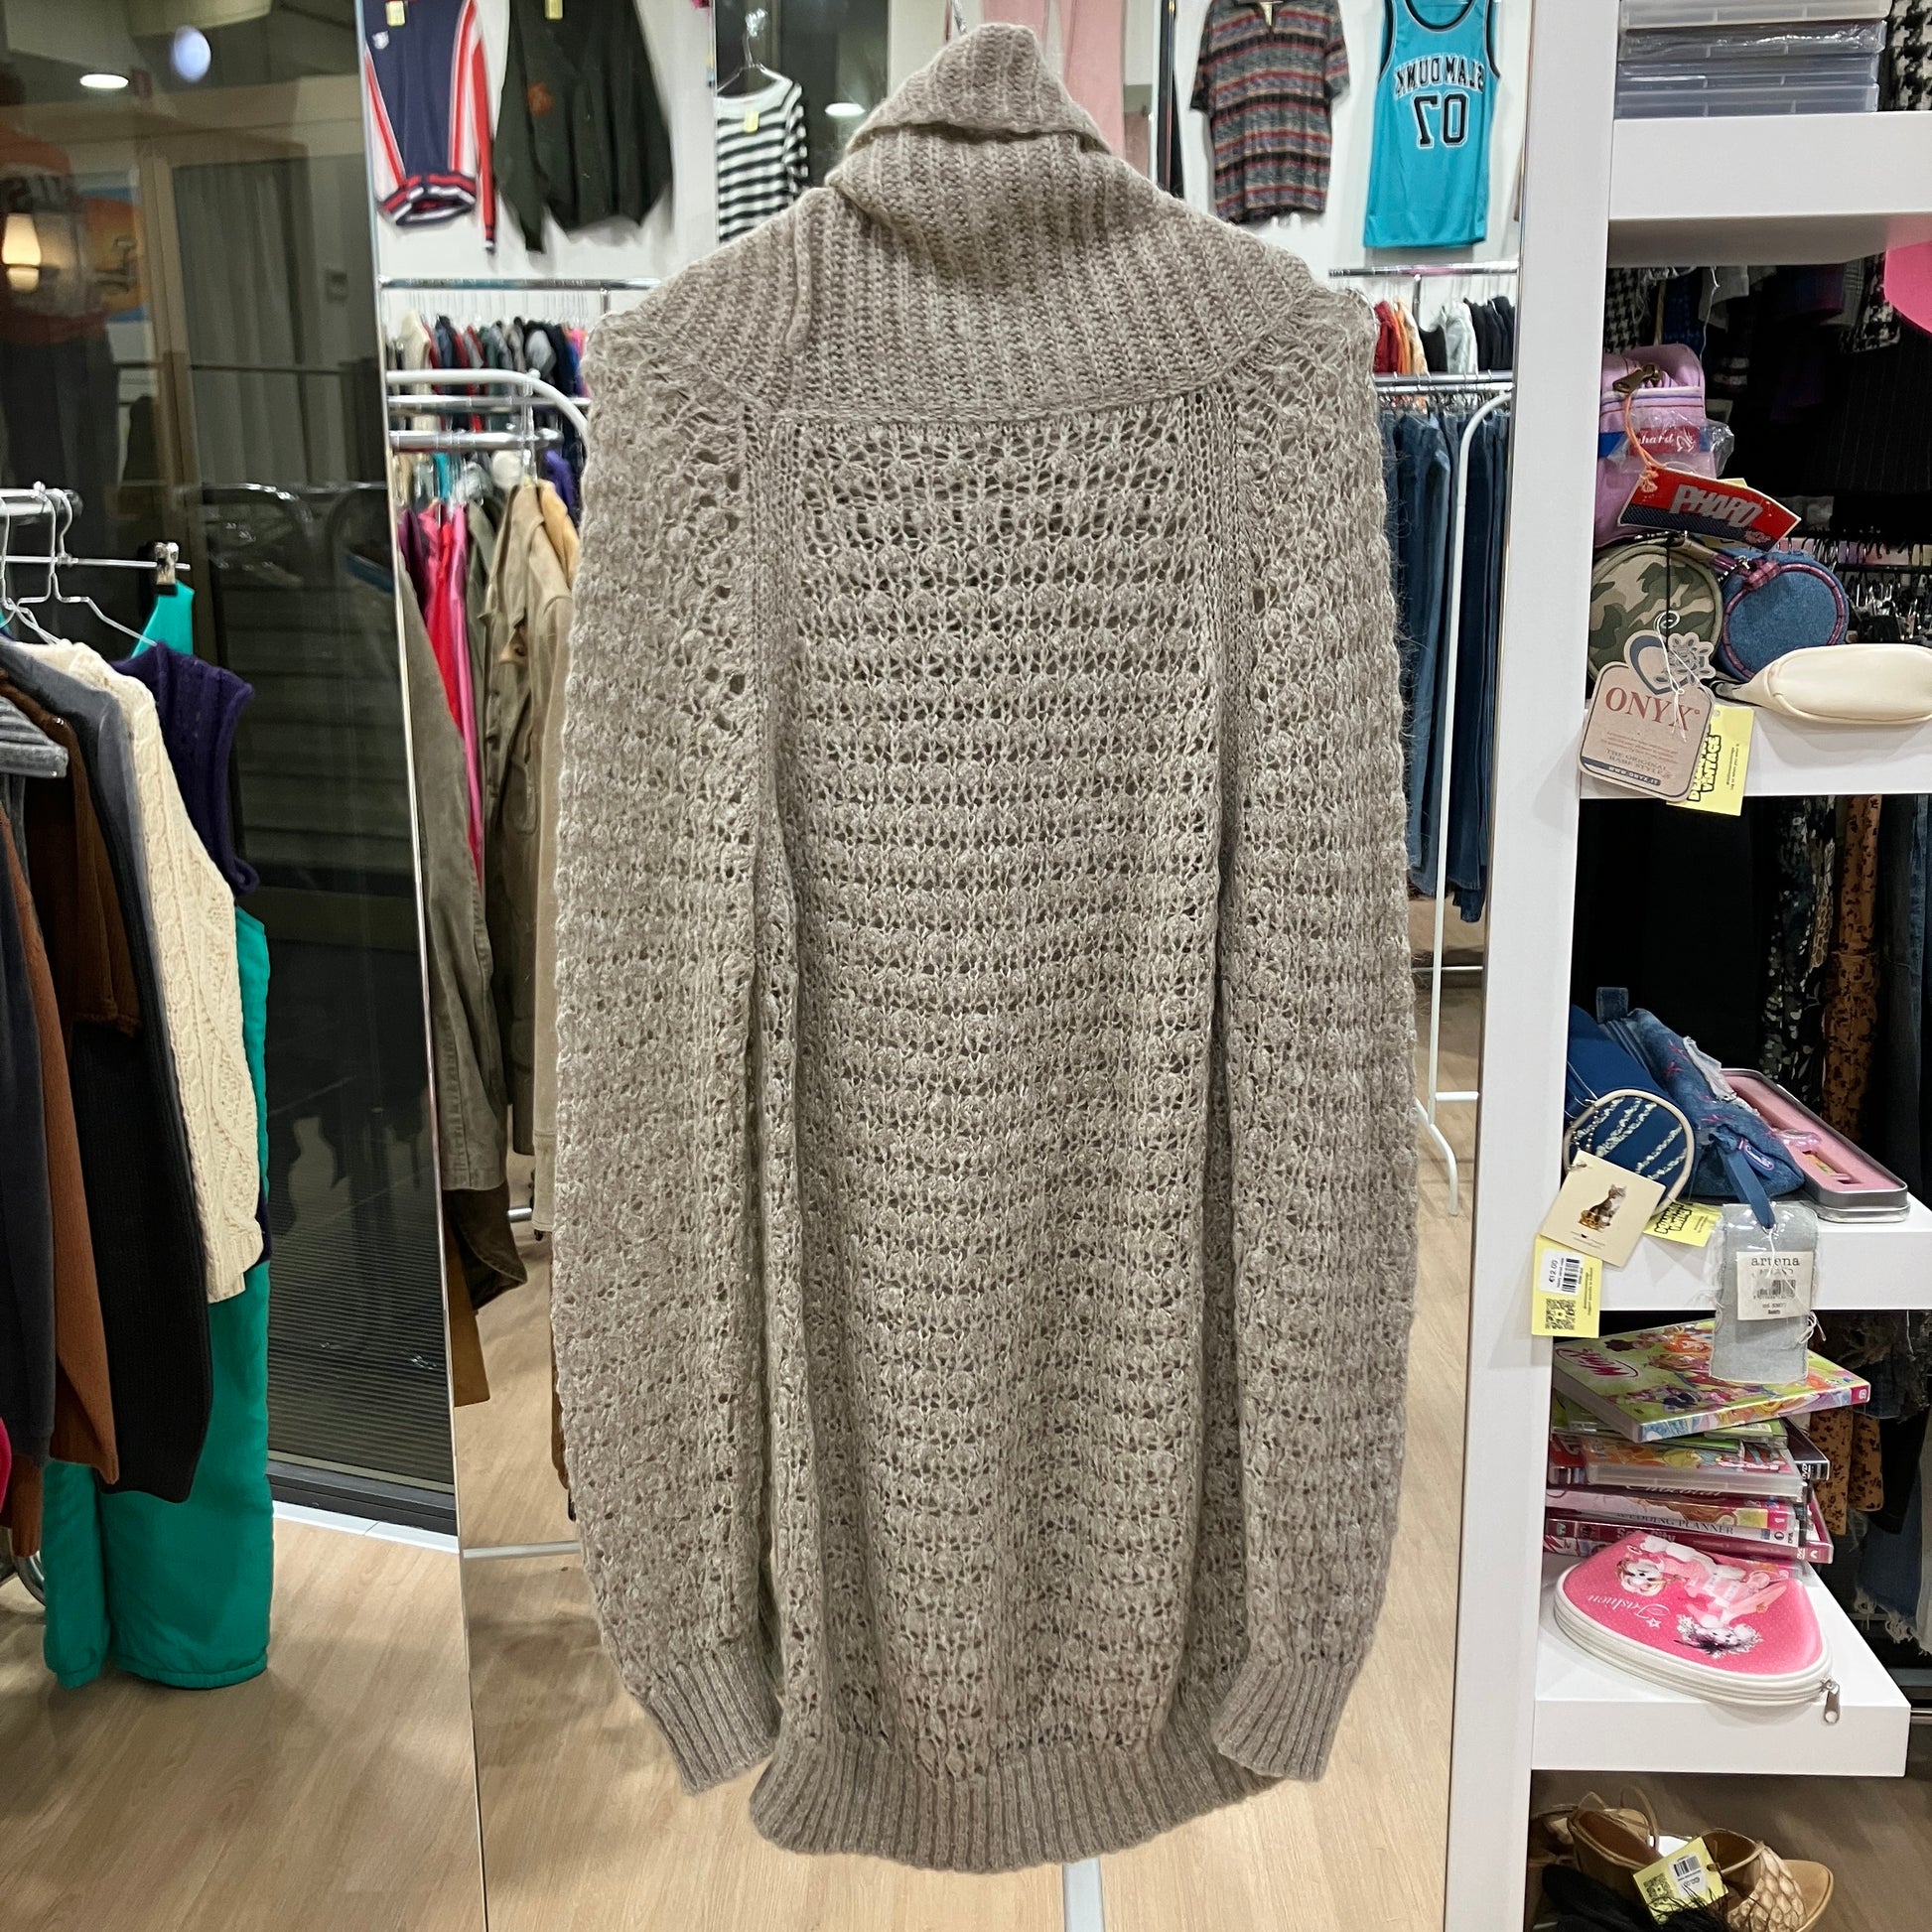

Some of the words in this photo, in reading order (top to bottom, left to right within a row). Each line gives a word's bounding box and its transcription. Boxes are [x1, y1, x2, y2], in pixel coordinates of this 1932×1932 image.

[1669, 484, 1764, 528] PHARO
[1605, 687, 1694, 732] ONYX
[1701, 735, 1723, 793] VINTAGE
[1678, 1519, 1734, 1535] PLANNER
